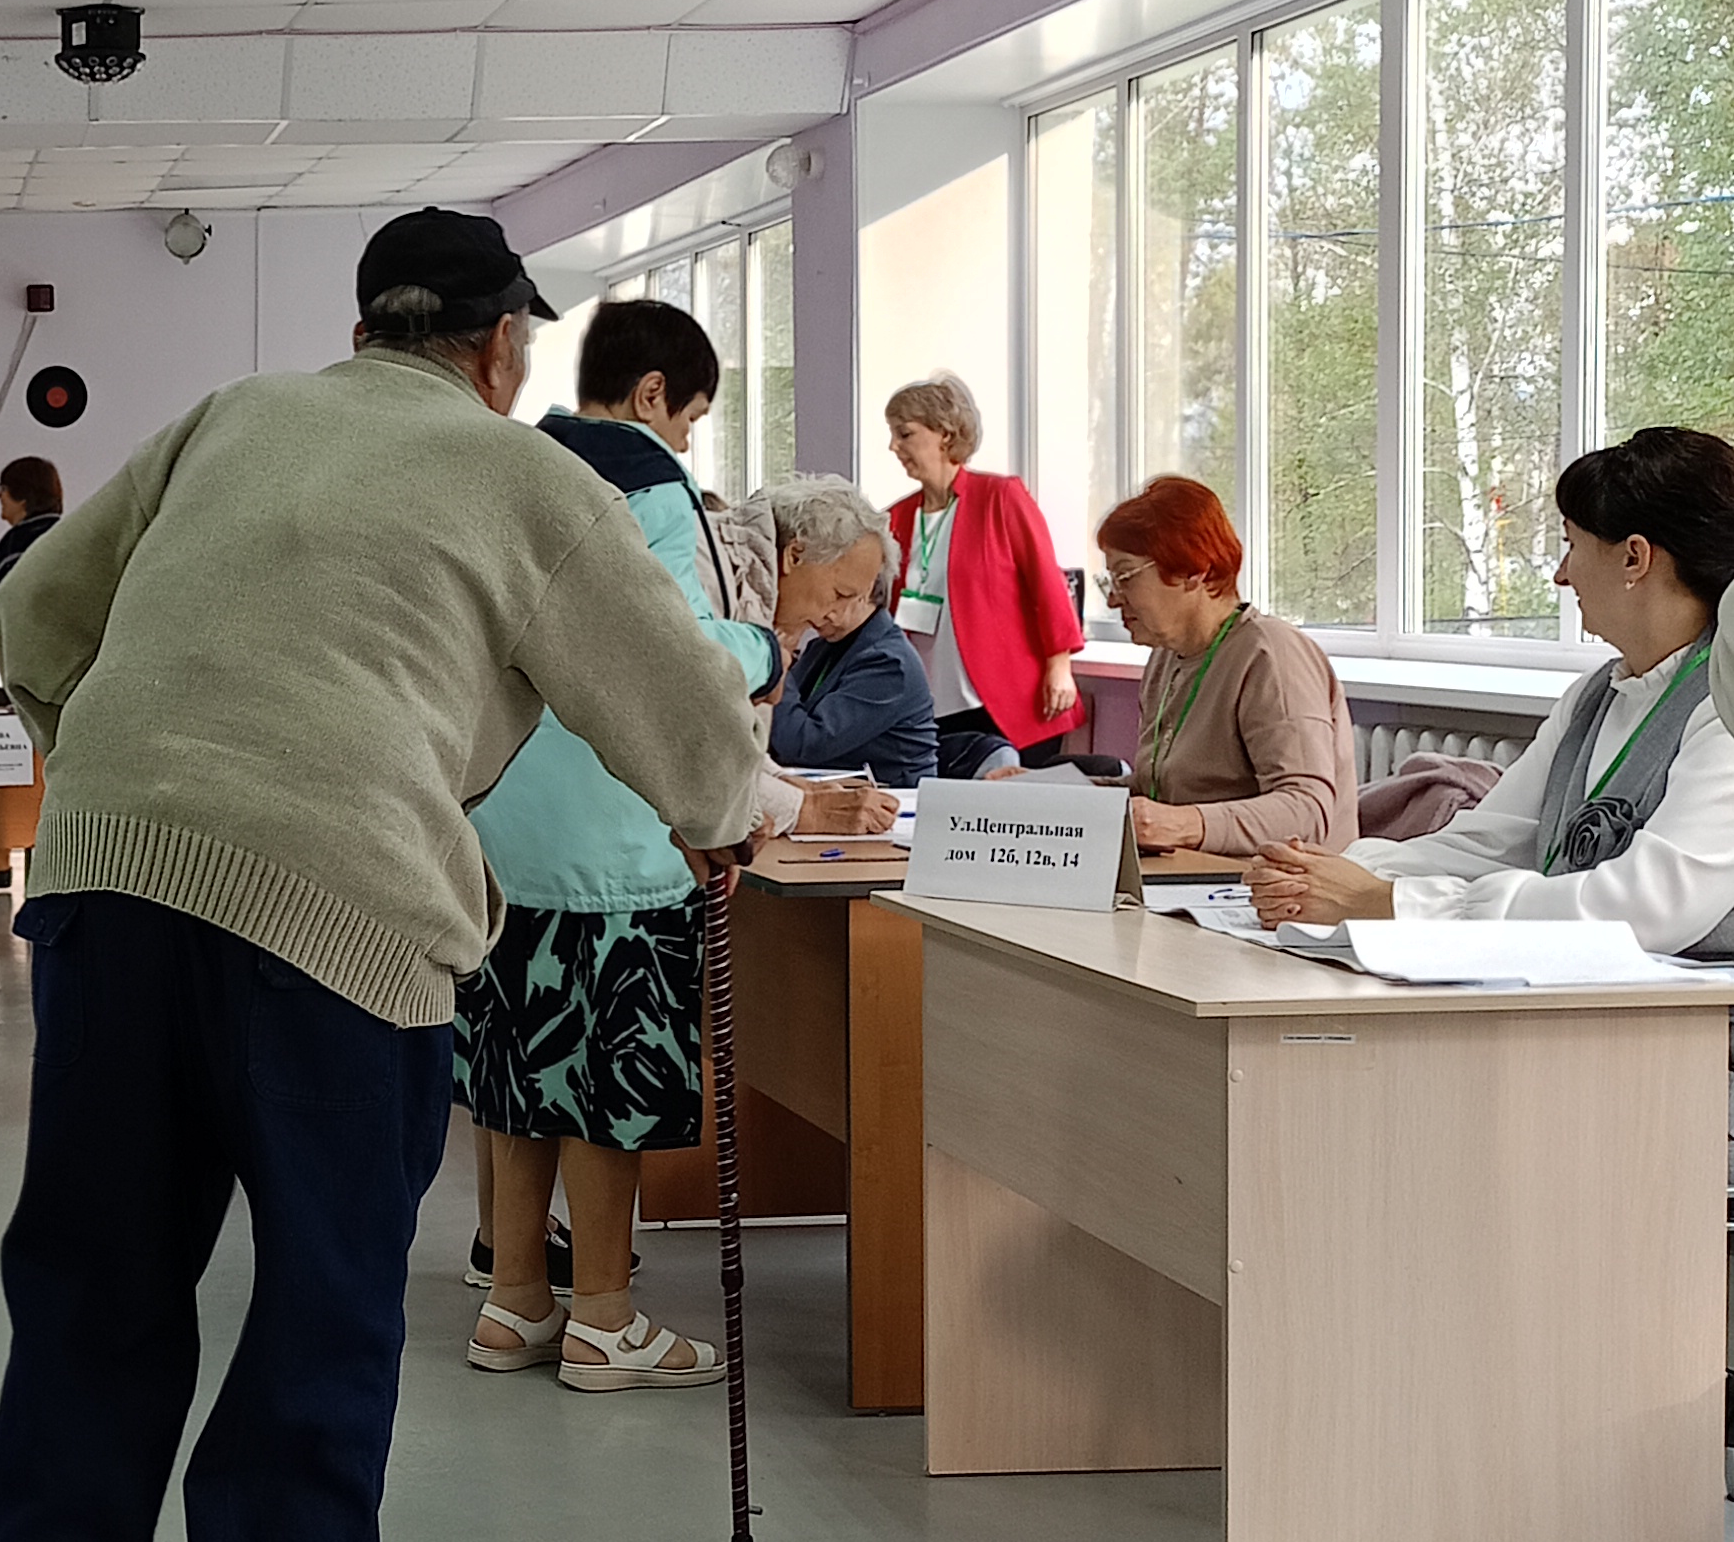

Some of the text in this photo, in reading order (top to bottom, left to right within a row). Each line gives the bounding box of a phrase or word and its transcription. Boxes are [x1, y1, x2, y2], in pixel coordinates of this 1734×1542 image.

[949, 816, 1084, 839] Ул.Центральная
[944, 848, 1079, 869] дом 12б, 12в, 14
